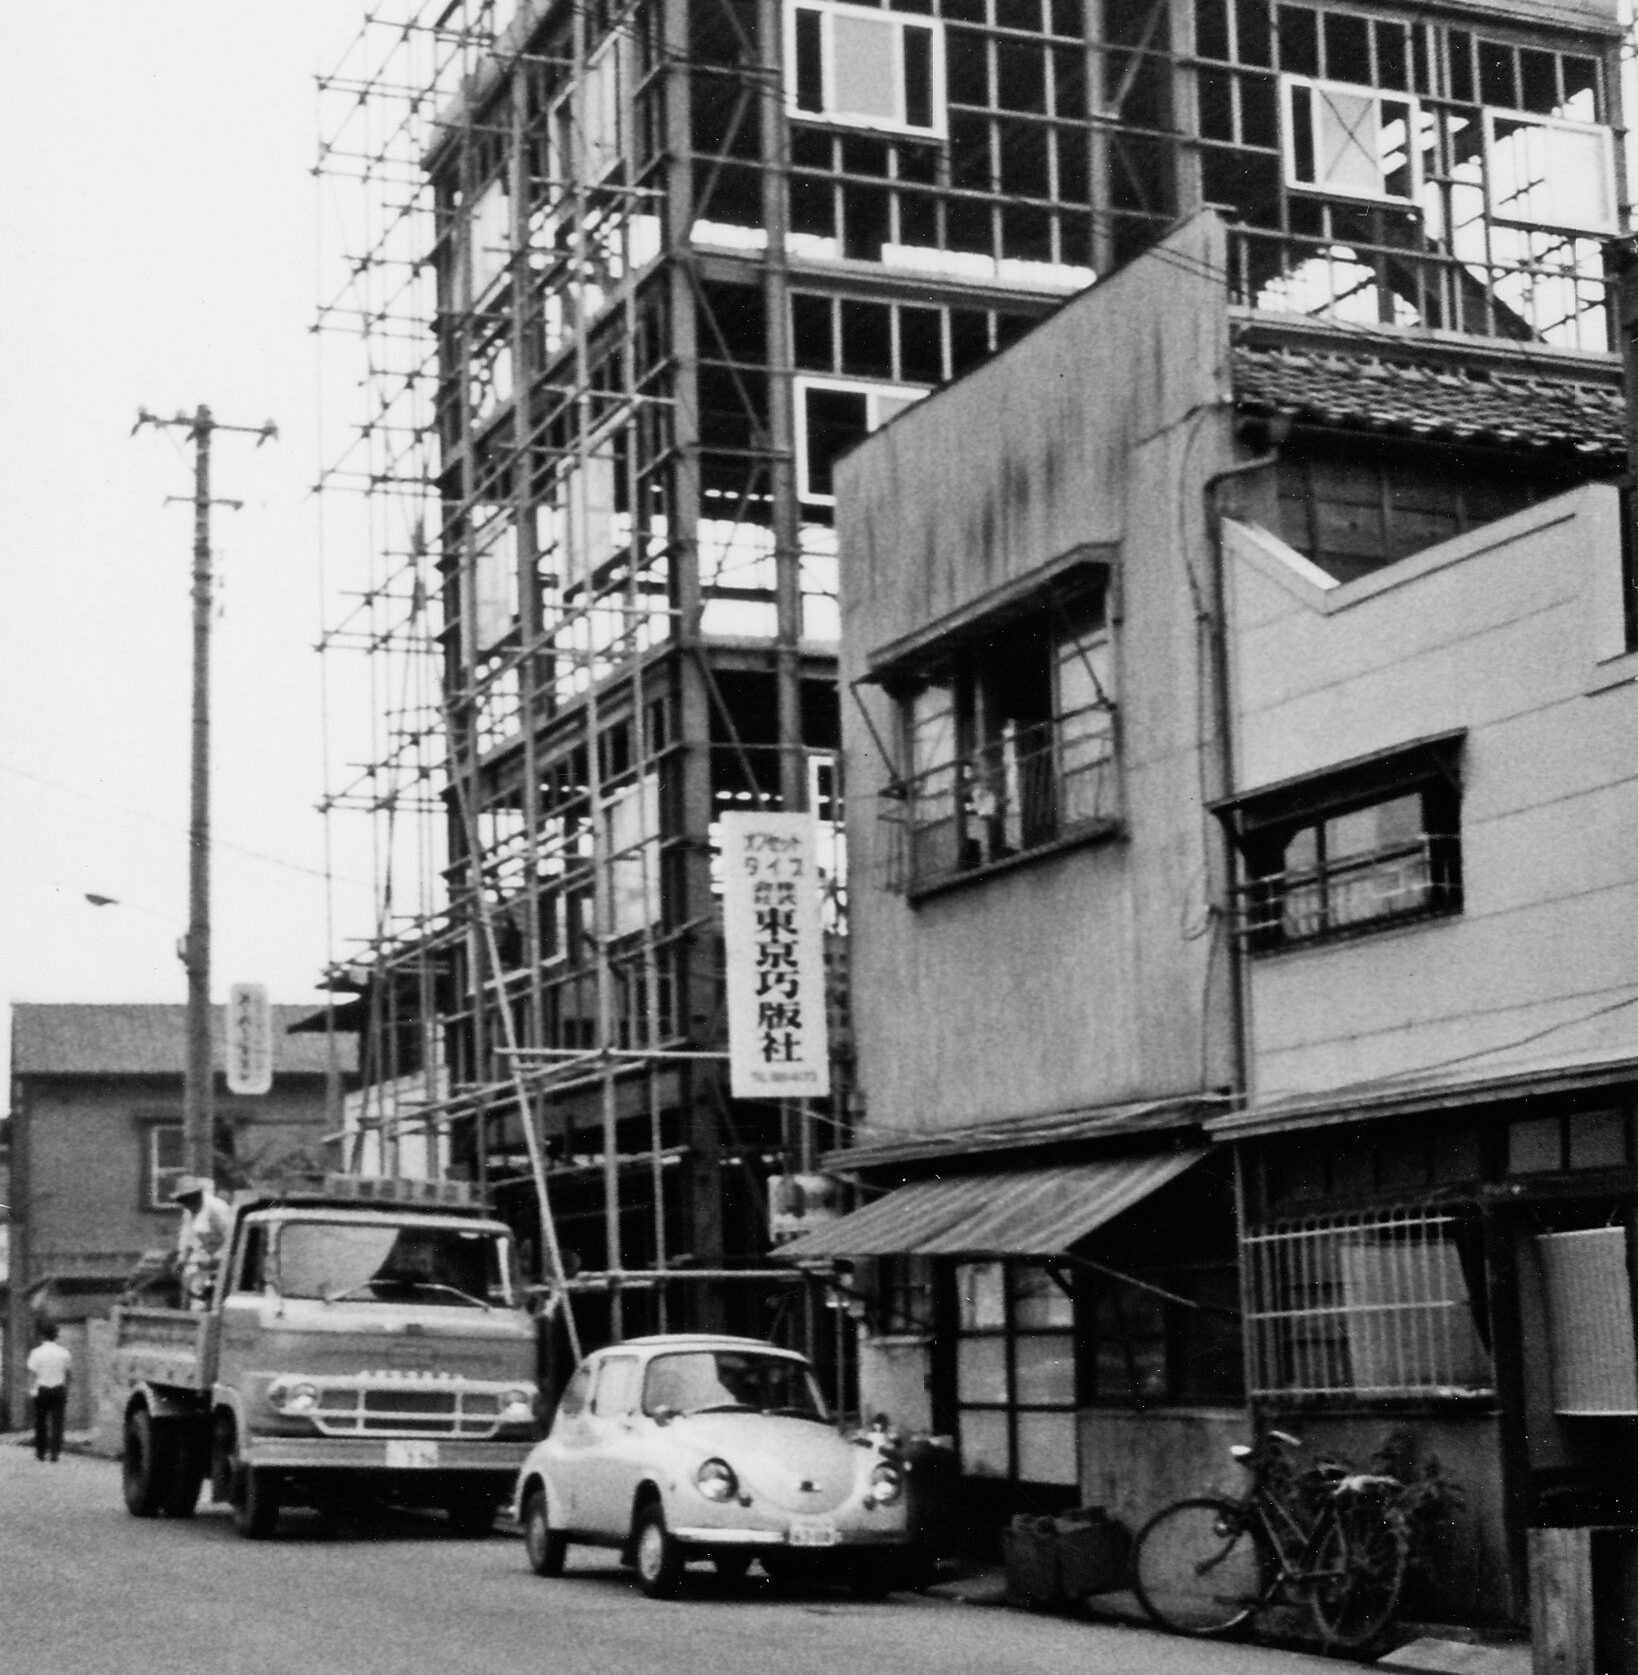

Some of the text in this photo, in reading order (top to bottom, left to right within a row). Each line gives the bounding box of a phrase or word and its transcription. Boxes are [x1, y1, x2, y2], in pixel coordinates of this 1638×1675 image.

[754, 907, 803, 1063] 東京巧版社
